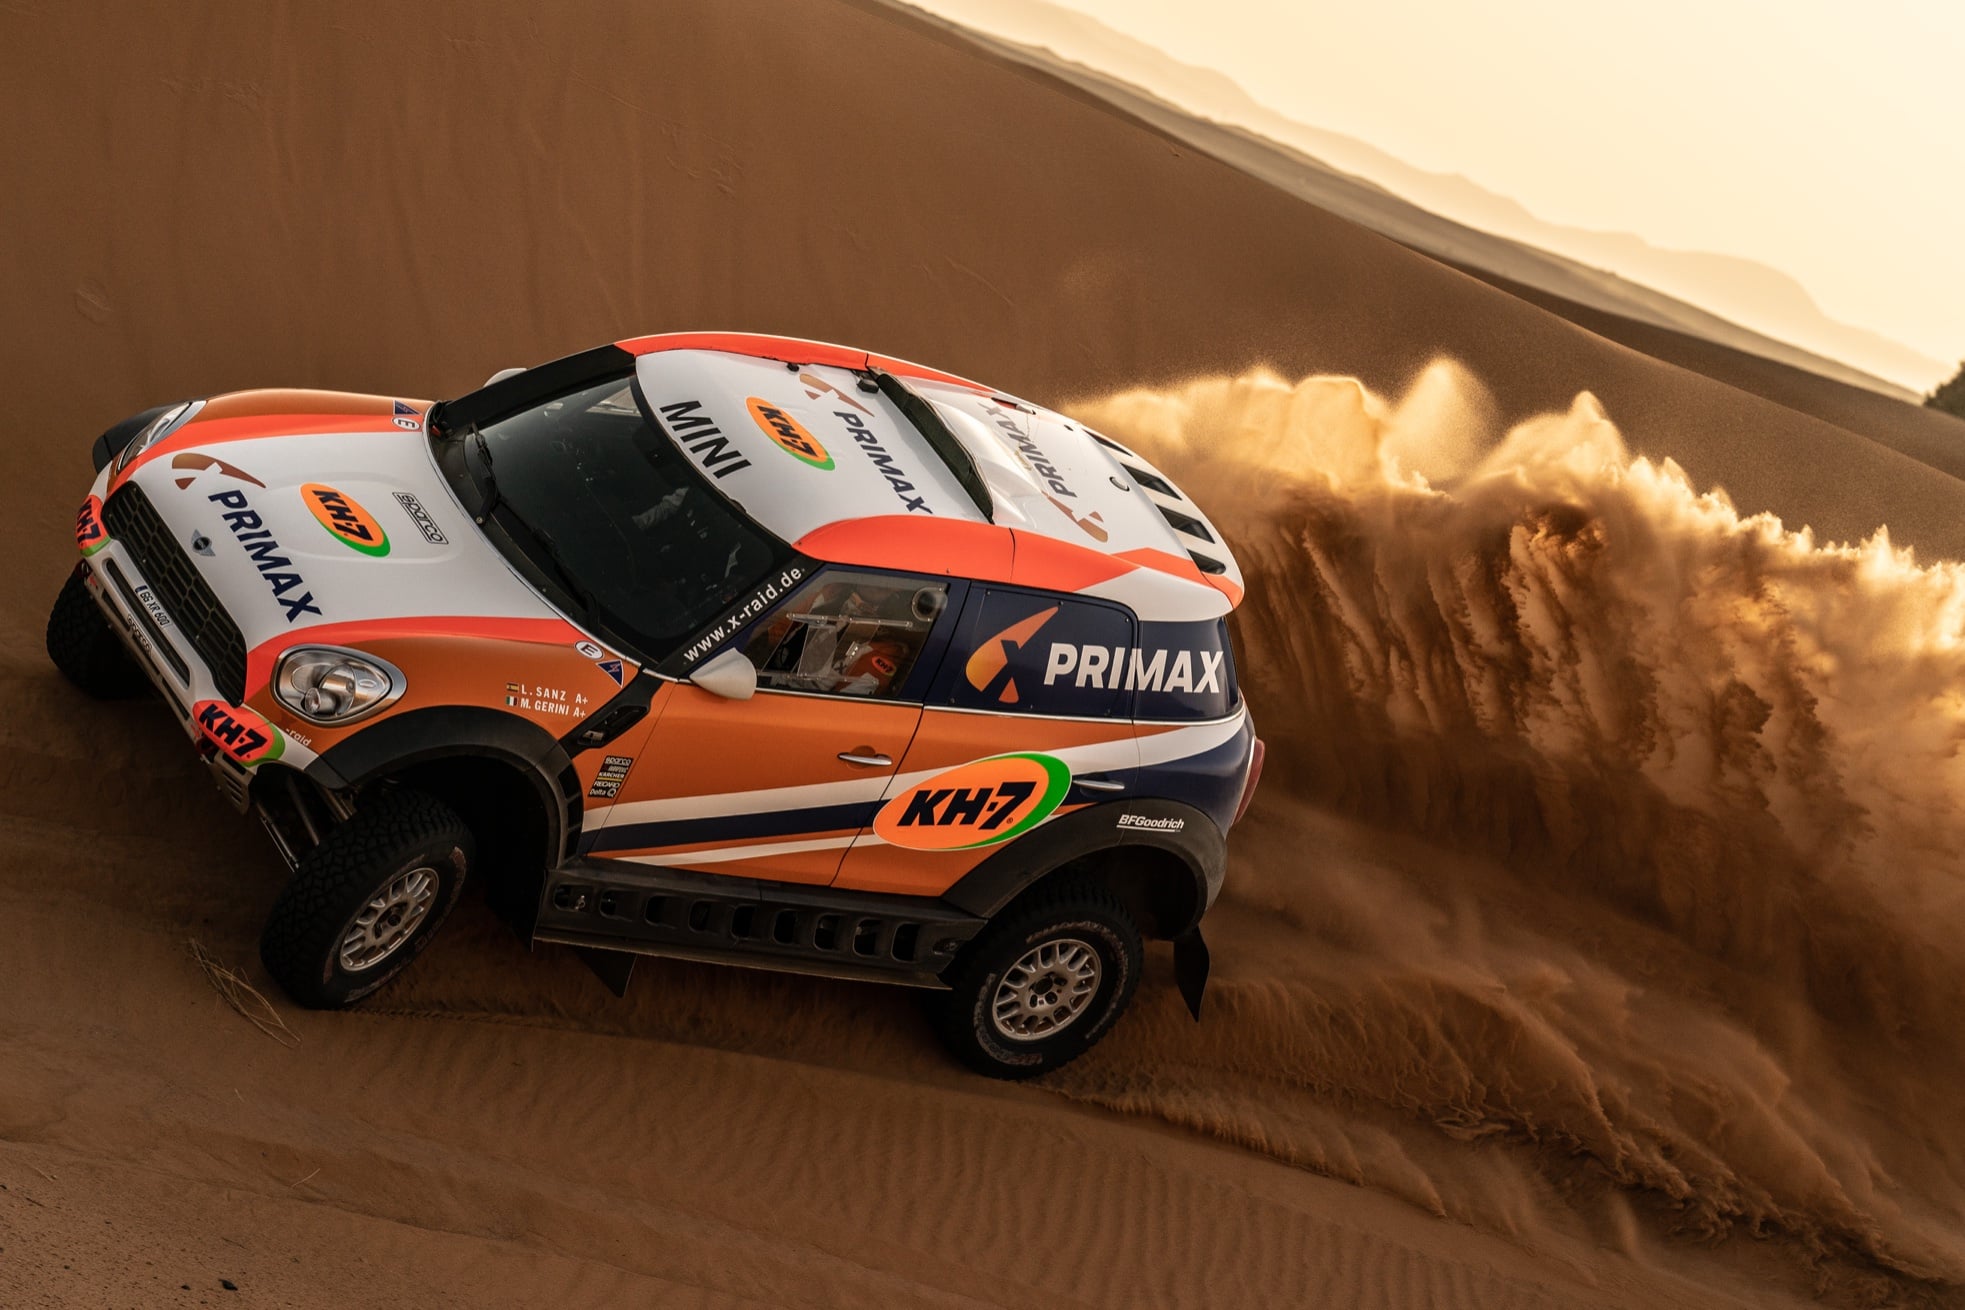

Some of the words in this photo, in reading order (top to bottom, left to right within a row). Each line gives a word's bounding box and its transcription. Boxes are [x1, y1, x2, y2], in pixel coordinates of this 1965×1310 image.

[659, 400, 752, 479] MINI
[833, 411, 933, 514] PRIMAX
[977, 402, 1077, 498] PRIMAX
[400, 494, 444, 542] sparco
[208, 490, 322, 622] PRIMAX
[154, 611, 170, 626] 600
[684, 566, 802, 662] www.x-raid.de
[581, 643, 598, 656] E
[1043, 643, 1224, 693] PRIMAX
[520, 698, 531, 709] M.
[534, 700, 570, 715] GERINI
[573, 707, 586, 718] A+
[536, 686, 566, 701] SANZ
[575, 693, 588, 705] A+
[1118, 814, 1185, 829] BFGoodrich
